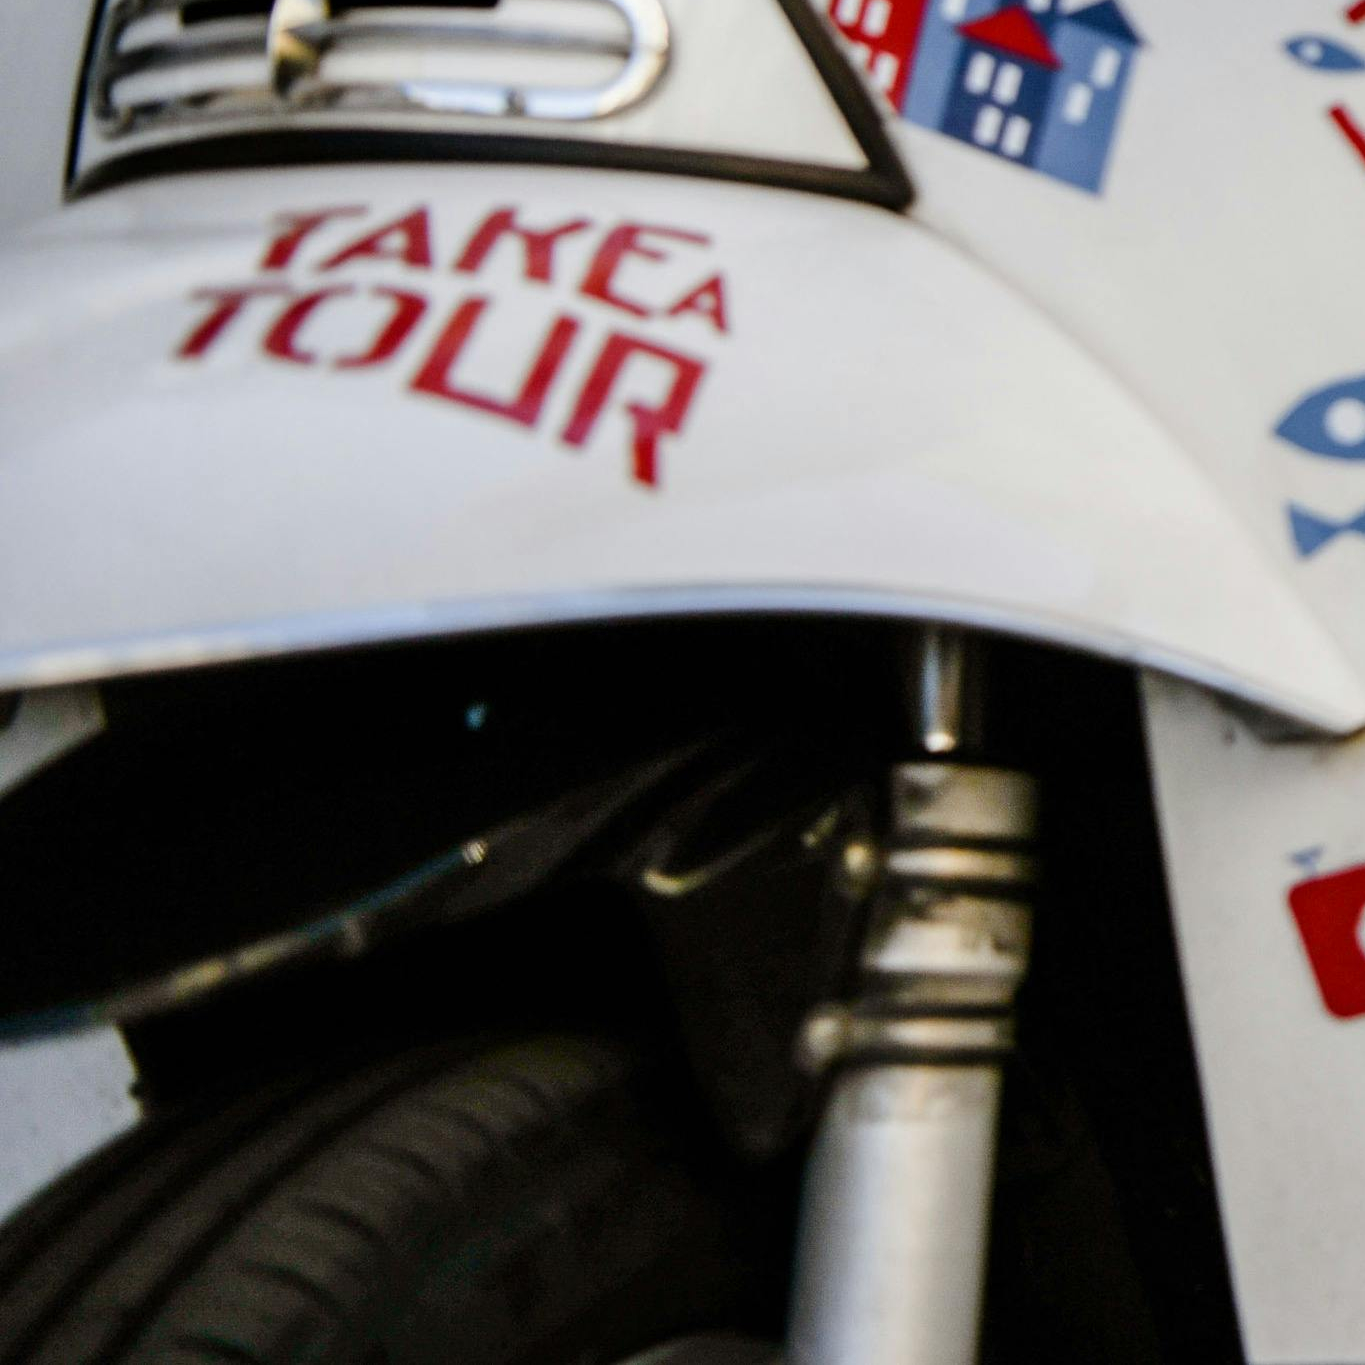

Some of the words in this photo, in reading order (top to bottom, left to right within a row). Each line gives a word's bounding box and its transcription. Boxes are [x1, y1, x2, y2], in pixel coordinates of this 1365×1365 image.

[258, 204, 712, 319] TAKE
[661, 269, 731, 335] A
[173, 283, 708, 490] TOUR
